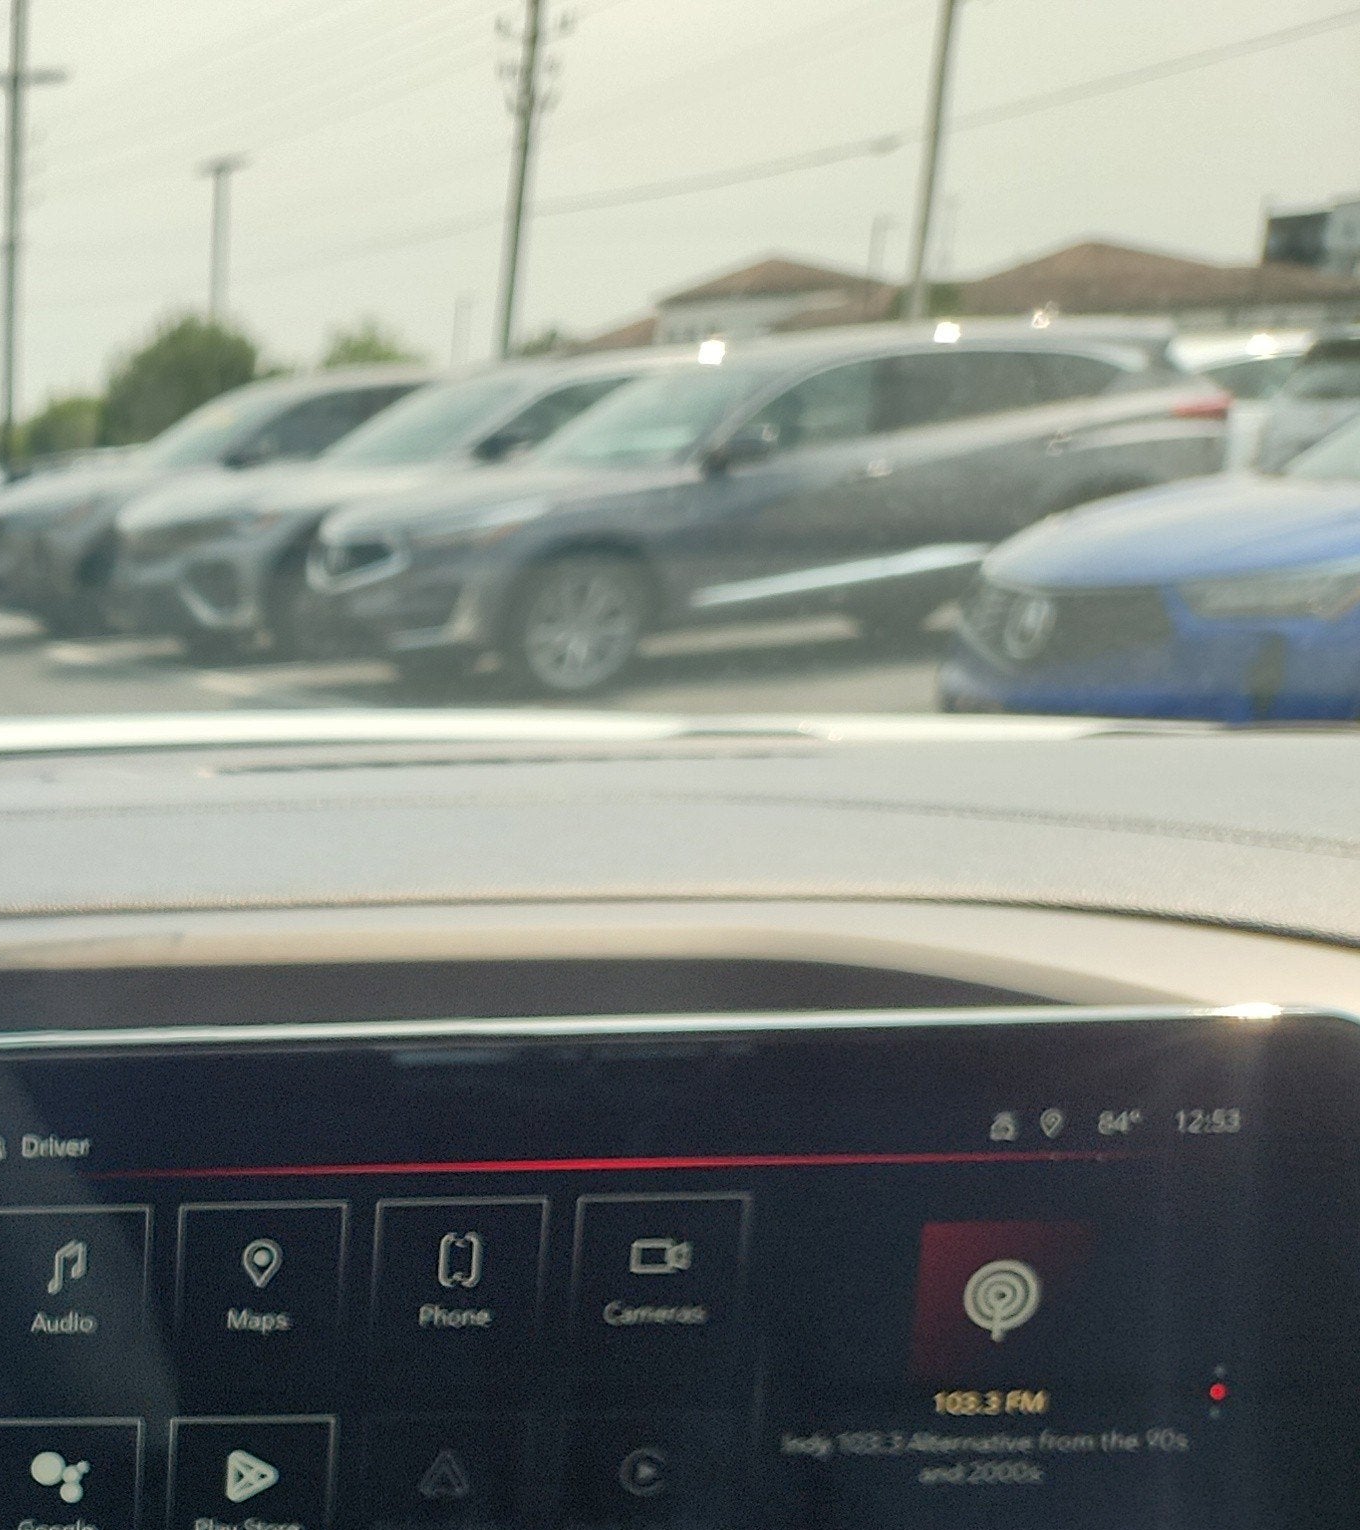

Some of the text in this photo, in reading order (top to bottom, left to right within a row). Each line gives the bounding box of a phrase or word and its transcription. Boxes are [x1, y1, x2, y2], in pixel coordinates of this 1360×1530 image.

[1175, 1108, 1241, 1134] 12:53
[21, 1134, 90, 1158] Driver
[30, 1309, 98, 1334] Audio
[226, 1308, 290, 1335] Maps
[418, 1303, 492, 1328] Phone
[603, 1301, 710, 1326] Cameras
[934, 1389, 1050, 1415] 103.3 FM
[1039, 1428, 1095, 1451] from
[1101, 1429, 1141, 1451] the
[1146, 1427, 1189, 1451] 90s
[919, 1460, 966, 1484] and
